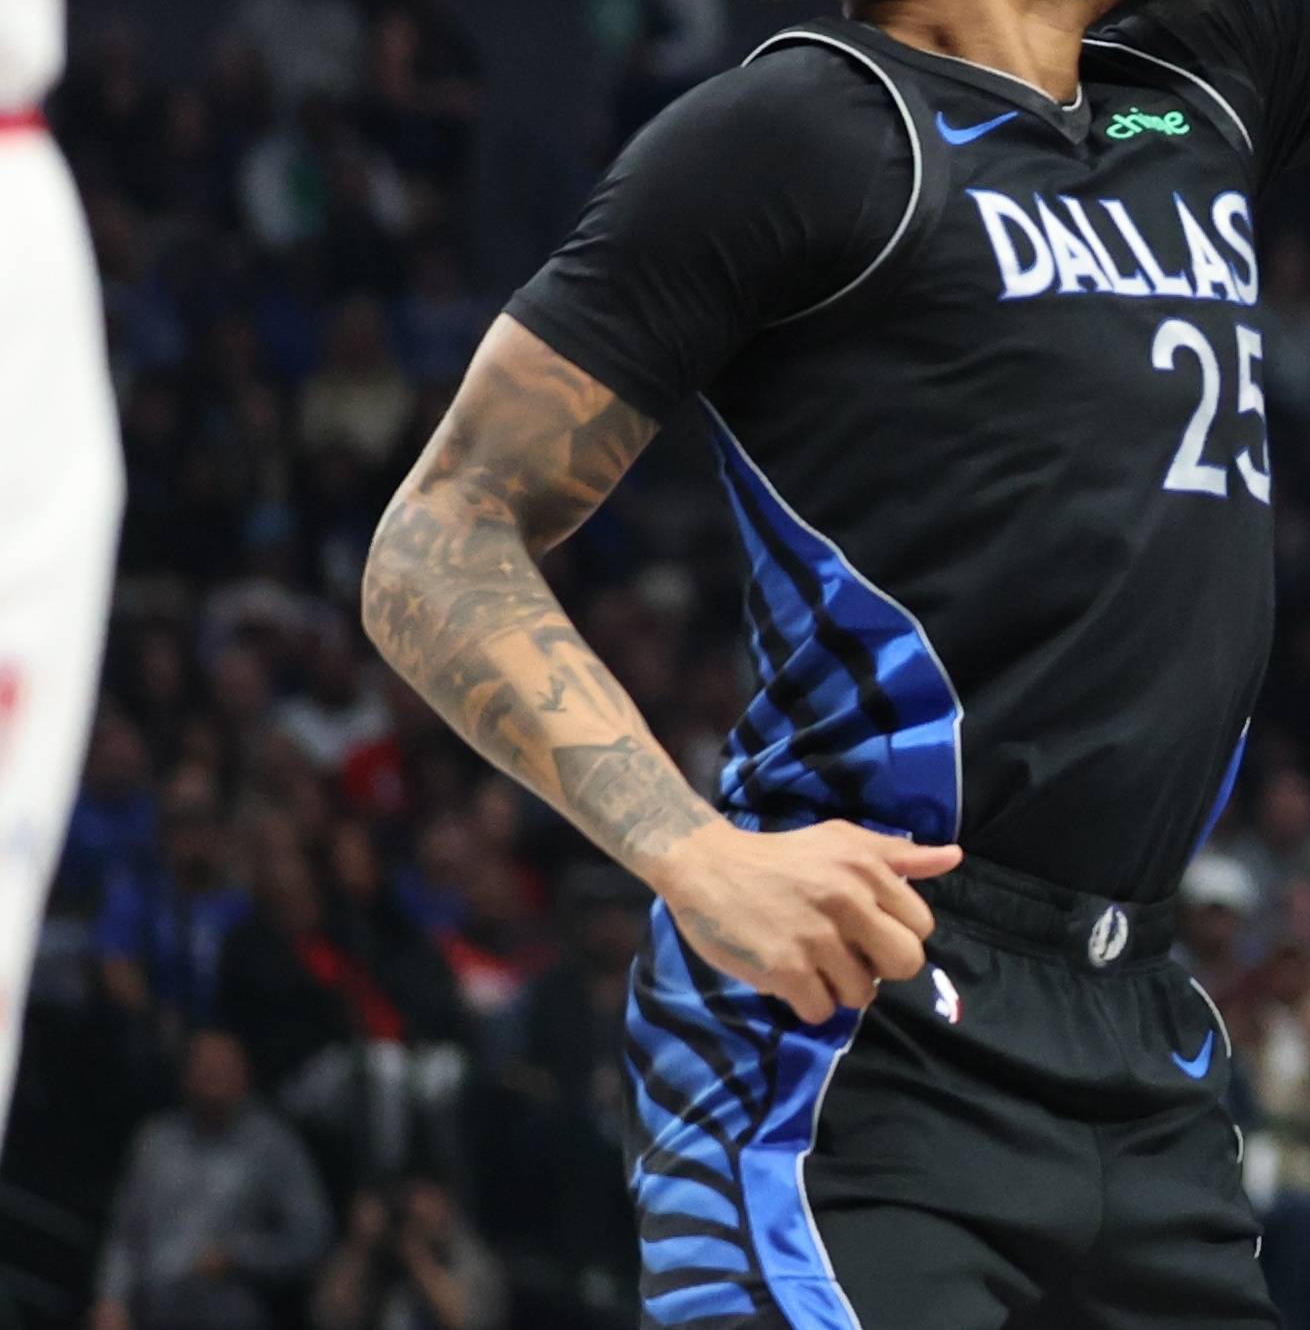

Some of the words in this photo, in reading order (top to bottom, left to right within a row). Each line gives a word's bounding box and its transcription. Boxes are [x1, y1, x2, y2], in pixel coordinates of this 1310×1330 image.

[1106, 107, 1190, 139] chime
[965, 187, 1258, 307] DALLAS
[1151, 318, 1271, 506] 25
